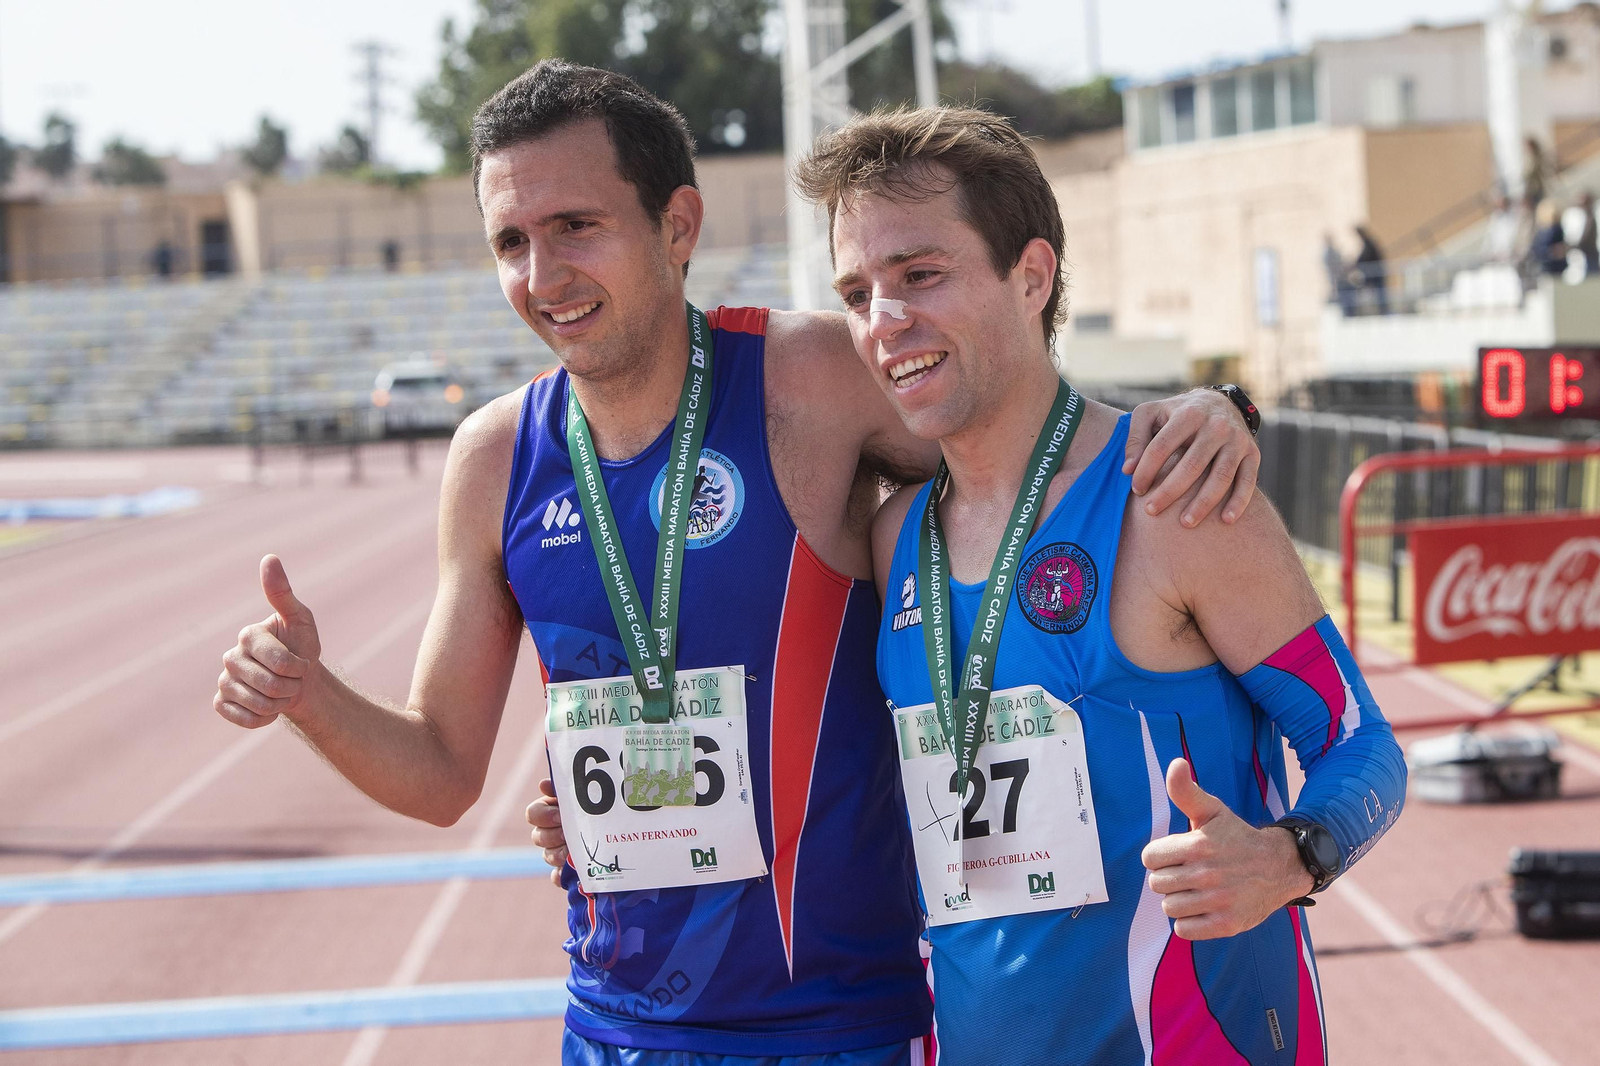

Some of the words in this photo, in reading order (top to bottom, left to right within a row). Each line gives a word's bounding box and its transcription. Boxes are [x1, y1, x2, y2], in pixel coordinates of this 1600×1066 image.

[688, 373, 703, 410] CÁDIZ
[684, 411, 696, 429] DE
[1045, 412, 1073, 453] MEDIA
[575, 430, 589, 464] XXXIII
[677, 431, 692, 470] BAHÍA
[583, 464, 599, 504] MEDIA
[1017, 456, 1053, 524] MARATÓN
[668, 473, 685, 535] MARATÓN
[541, 530, 581, 549] mobel
[593, 504, 618, 563] MARATÓN
[700, 511, 739, 546] FERNANDO
[929, 528, 941, 562] MEDIA
[662, 538, 675, 579] MEDIA
[999, 527, 1024, 571] BAHÍA
[1020, 569, 1030, 582] DE
[1028, 546, 1070, 569] ATLETISMO
[1070, 548, 1094, 587] CARMONA
[611, 564, 631, 603] BAHÍA
[659, 583, 671, 619] XXXIII
[930, 565, 944, 624] MARATÓN
[993, 574, 1007, 595] DE
[624, 604, 638, 622] DE
[980, 598, 1001, 644] CÁDIZ
[630, 623, 650, 660] CÁDIZ
[933, 627, 946, 668] BAHÍA
[567, 688, 598, 702] XXXIII
[672, 675, 719, 692] RATÓN
[938, 669, 947, 688] DE
[566, 703, 622, 727] BAHÍA
[674, 696, 722, 718] ÁDIZ
[964, 700, 980, 743] XXXIII
[1001, 715, 1055, 740] CÁDIZ
[653, 738, 663, 746] DE
[949, 758, 1030, 841] 27
[605, 834, 619, 843] UA
[620, 832, 640, 842] SAN
[641, 828, 698, 841] FERNANDO
[989, 850, 1051, 867] G-CUBILLANA
